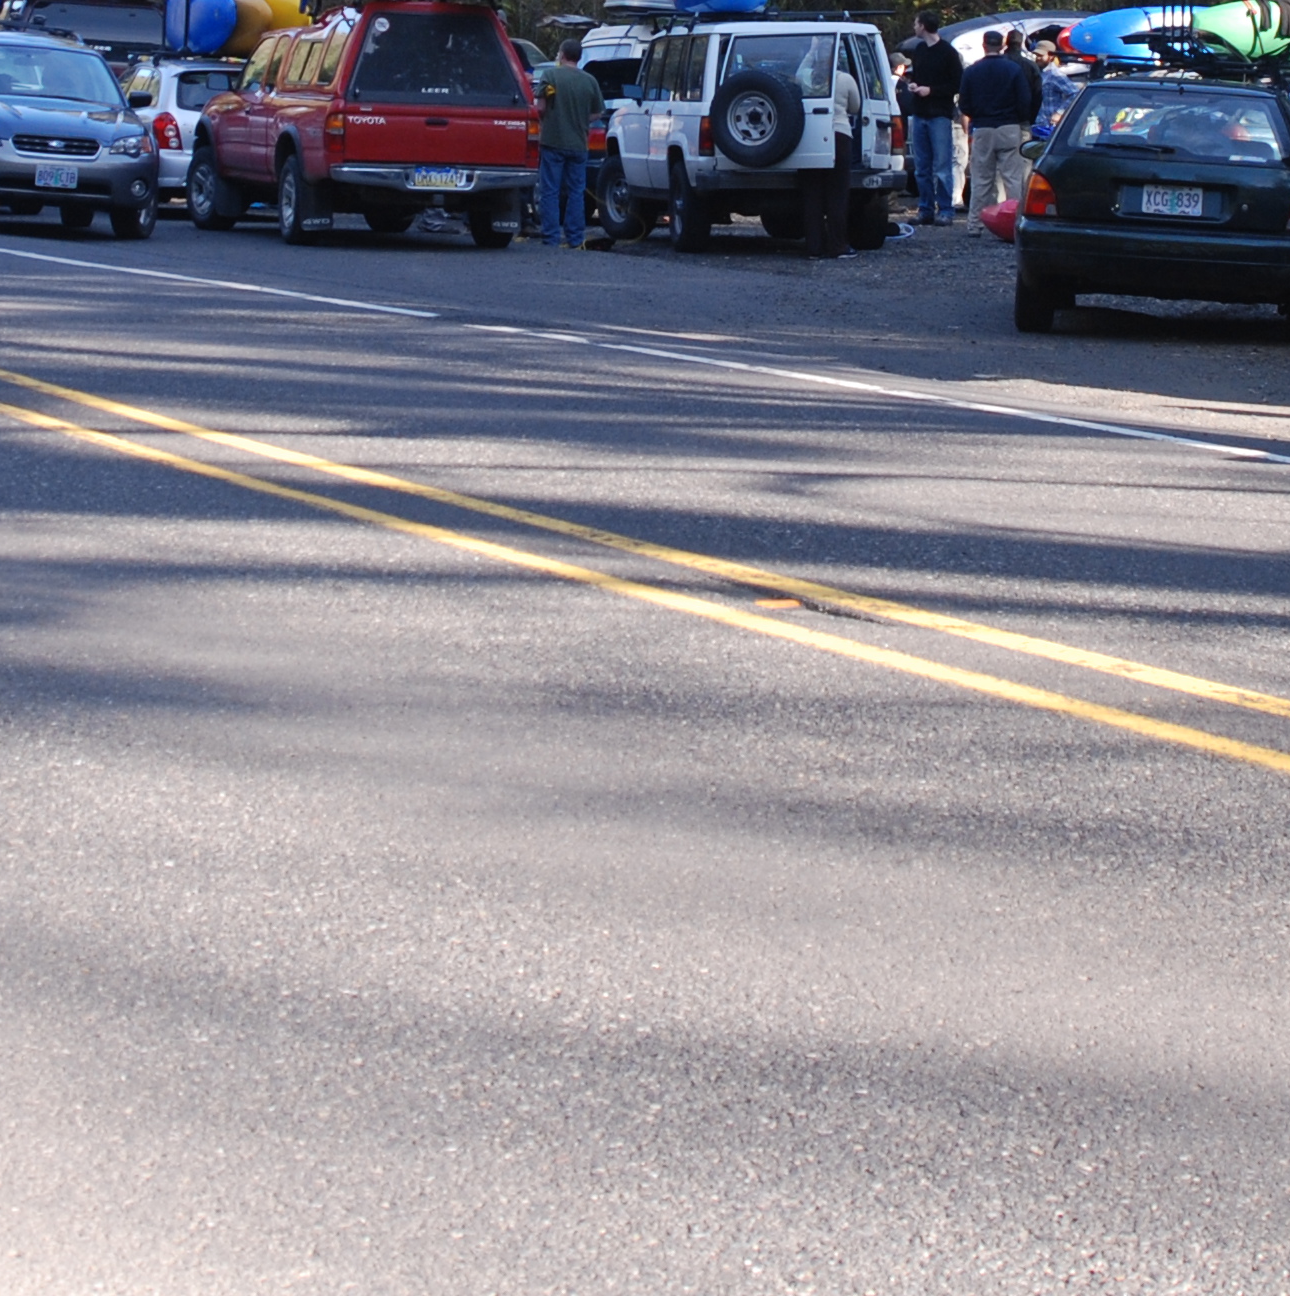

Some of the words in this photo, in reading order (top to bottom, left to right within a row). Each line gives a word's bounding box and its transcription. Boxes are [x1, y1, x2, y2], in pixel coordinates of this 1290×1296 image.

[348, 115, 386, 125] TOYOTA
[1145, 190, 1170, 207] XCG
[1175, 191, 1200, 209] 839
